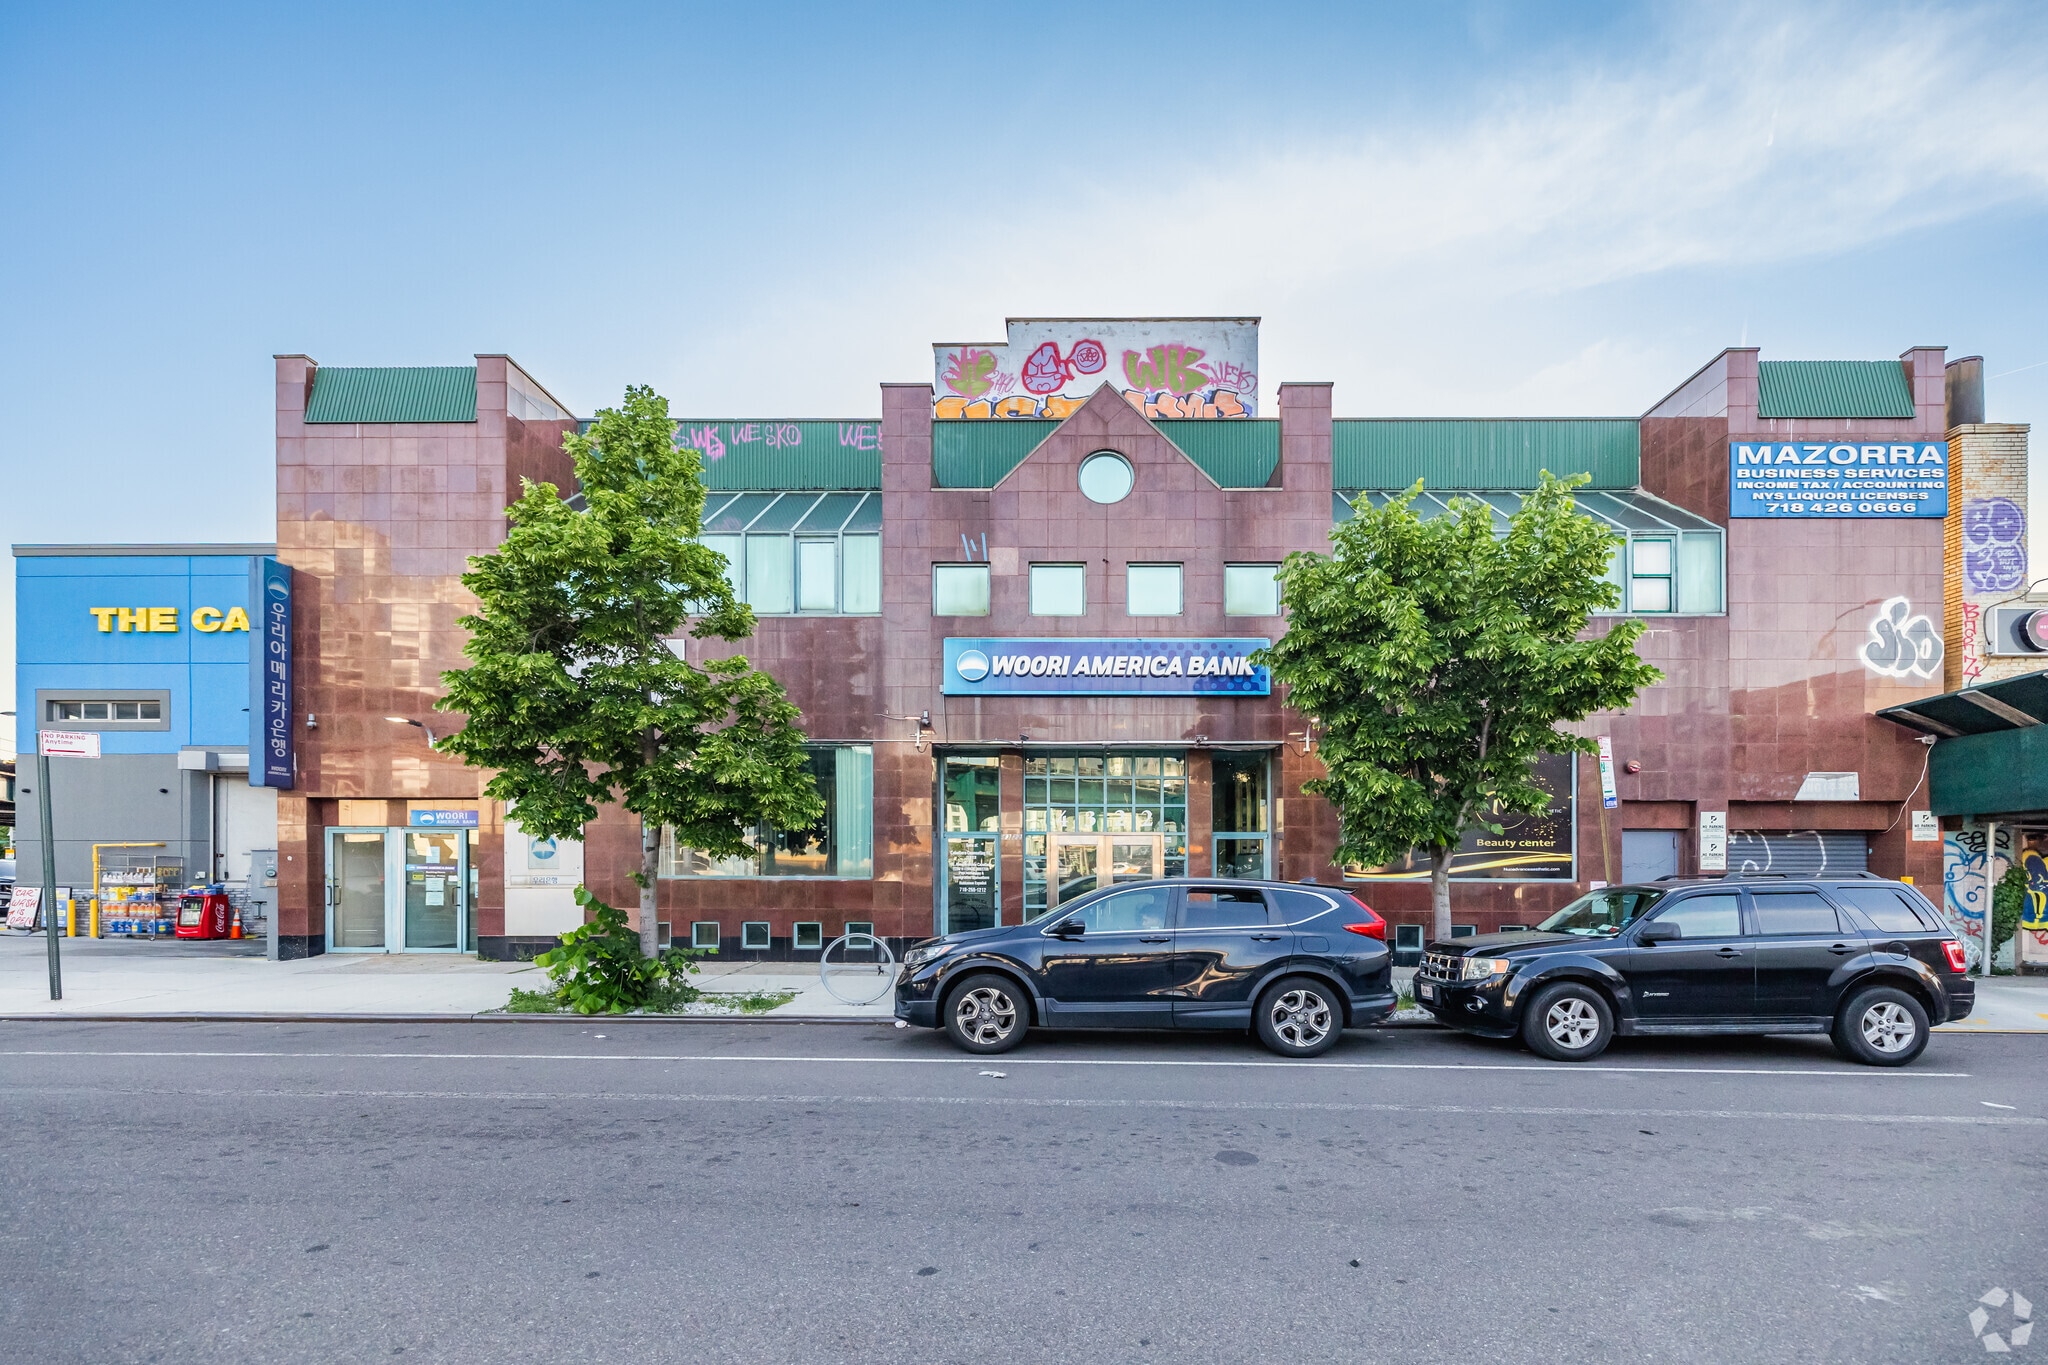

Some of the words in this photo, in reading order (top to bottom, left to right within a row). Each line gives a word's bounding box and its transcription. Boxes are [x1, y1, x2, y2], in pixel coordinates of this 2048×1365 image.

[839, 423, 882, 450] WE
[1738, 445, 1944, 465] MAZORRA
[1736, 469, 1840, 479] BUSINESS
[1844, 469, 1945, 479] SERVICES
[1737, 481, 1799, 490] INCOME
[1801, 481, 1830, 490] TAX
[1833, 481, 1840, 490] /
[1842, 481, 1945, 490] ACCOUNTING
[1752, 492, 1785, 500] NYS
[1787, 492, 1848, 501] LIQUOR
[1850, 492, 1929, 500] LICENSES
[1765, 503, 1805, 514] 718
[1809, 503, 1853, 514] 426
[1857, 503, 1917, 514] 0666
[90, 607, 179, 633] THE
[992, 655, 1068, 677] WOORI
[1071, 655, 1187, 677] AMERICA
[1186, 655, 1256, 677] BANK
[435, 812, 468, 820] WOORI
[1476, 838, 1517, 849] Beauty
[1518, 838, 1557, 847] center
[11, 899, 38, 908] WASH
[10, 917, 34, 925] OPEN
